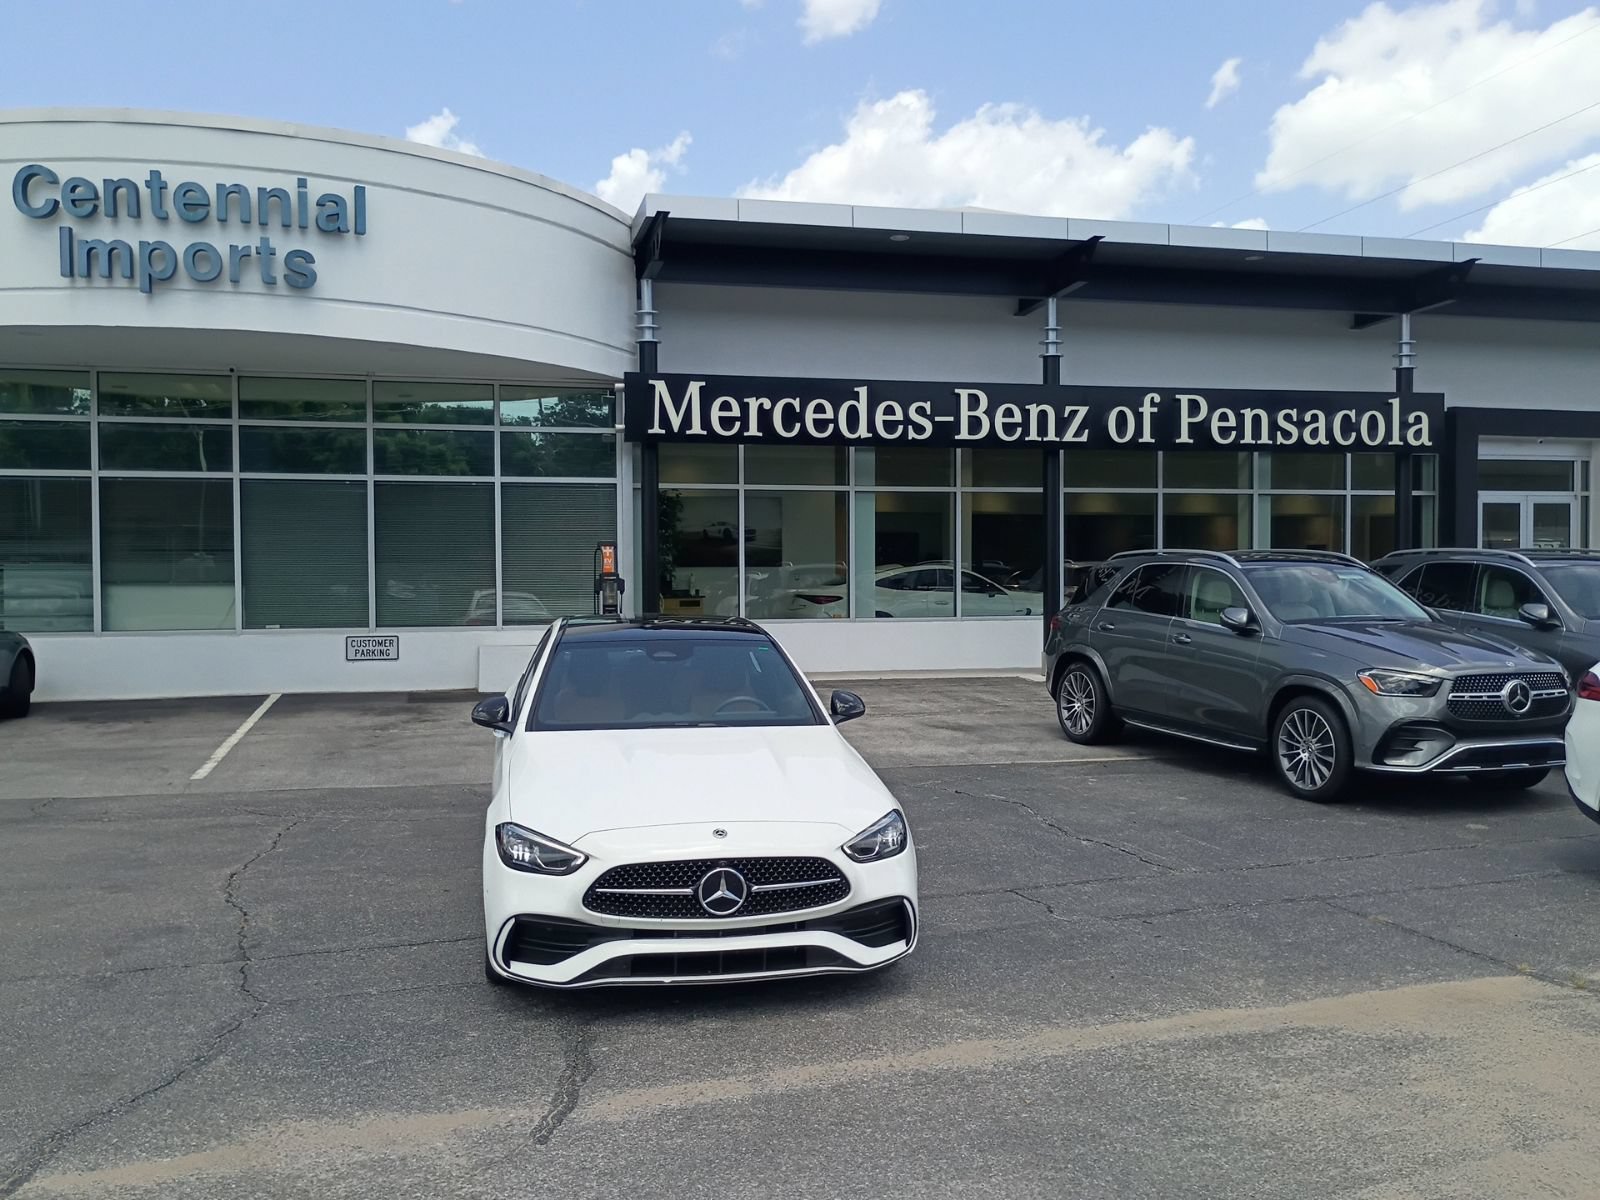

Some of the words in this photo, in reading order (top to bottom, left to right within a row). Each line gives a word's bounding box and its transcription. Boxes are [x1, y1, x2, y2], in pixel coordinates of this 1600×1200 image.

[12, 164, 367, 236] Centennial
[59, 226, 318, 294] Imports
[647, 379, 1090, 442] Mercedes-Benz
[1107, 392, 1162, 444] of
[1175, 394, 1433, 447] Pensacola
[350, 639, 394, 648] CUSTOMER
[354, 648, 391, 657] PARKING
